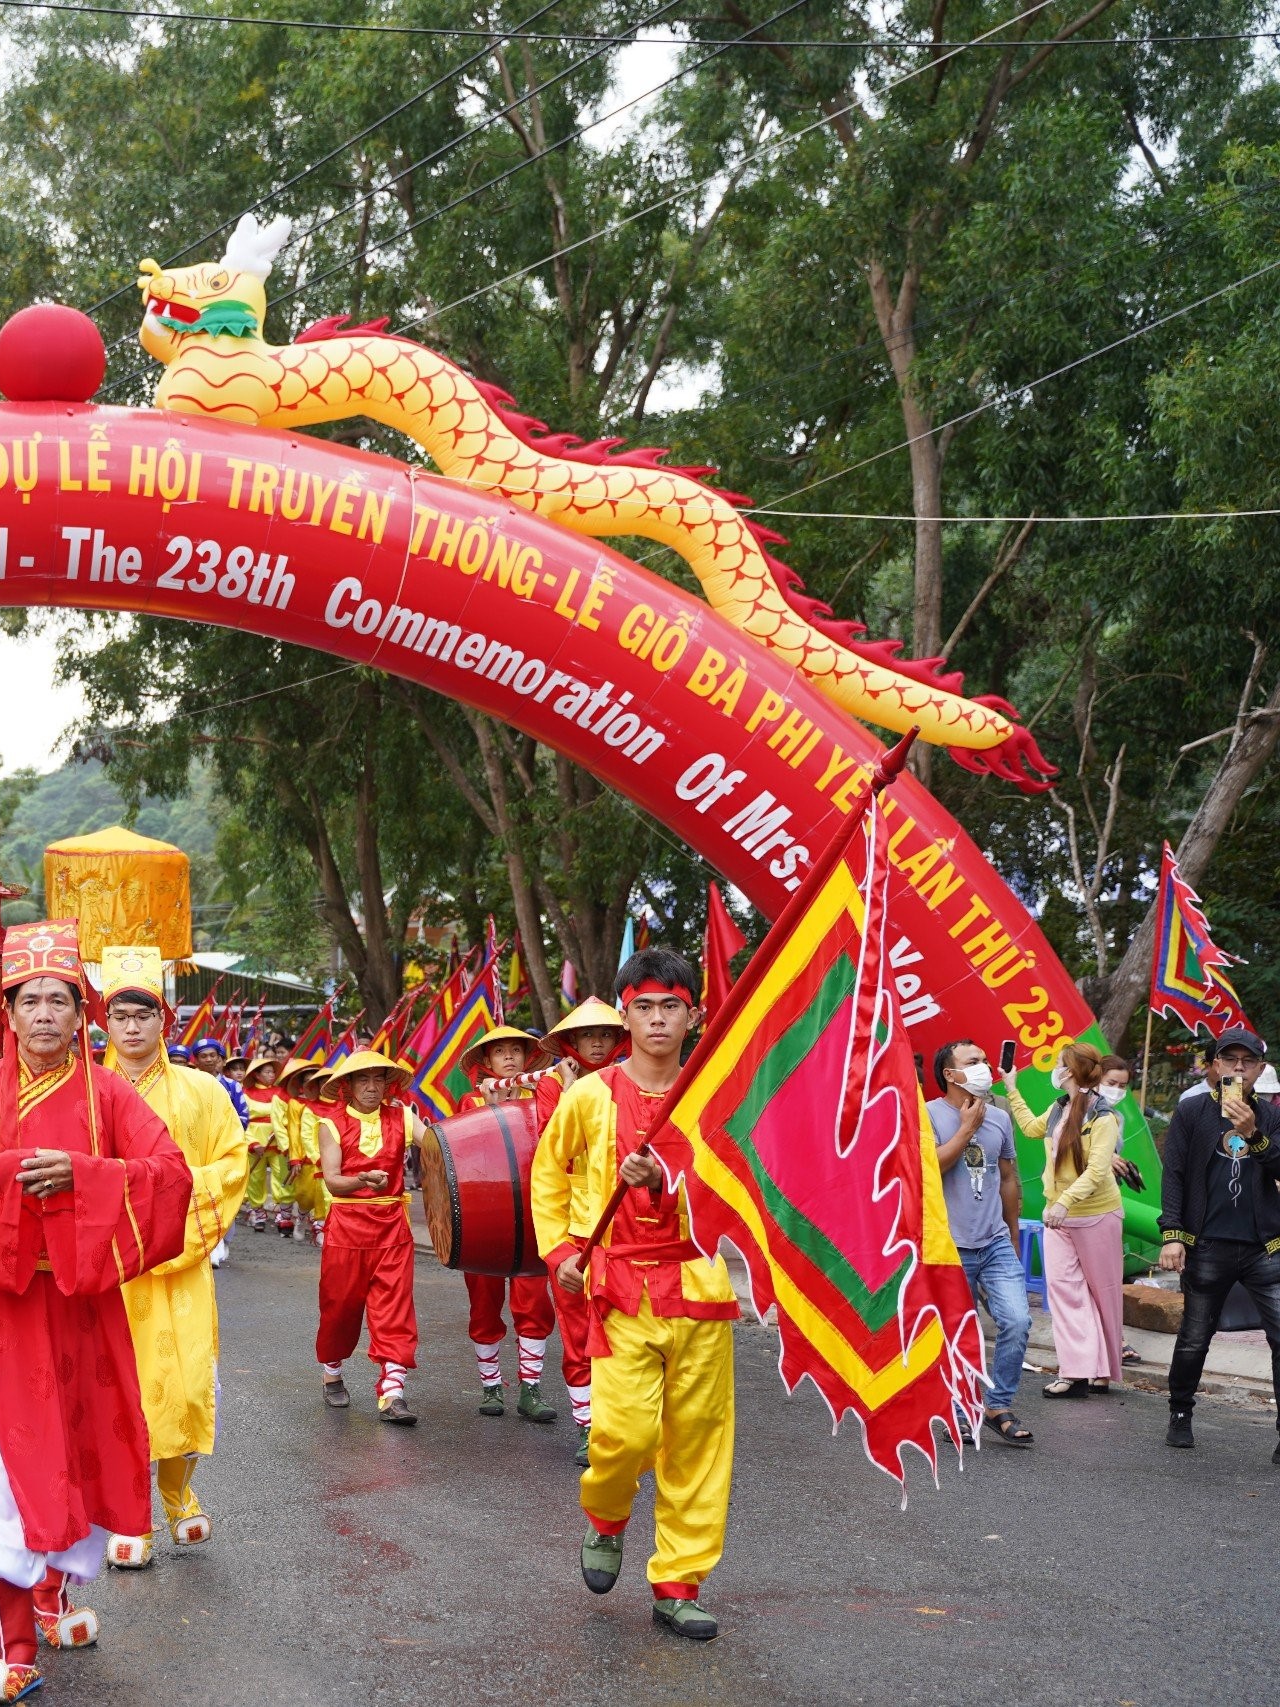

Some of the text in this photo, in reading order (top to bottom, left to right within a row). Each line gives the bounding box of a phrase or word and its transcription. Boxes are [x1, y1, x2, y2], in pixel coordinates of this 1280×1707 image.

[59, 422, 113, 493] LỄ
[128, 438, 203, 514] HỘI
[227, 457, 392, 546] TRUYỀN
[617, 603, 695, 673] GIỖ
[685, 645, 749, 717] BÀ
[745, 689, 825, 770] PHI
[887, 815, 966, 912] LẦN
[948, 893, 1036, 989] THỨ
[1002, 986, 1075, 1073] 238
[61, 526, 143, 584] The
[157, 535, 296, 609] 238th
[323, 575, 667, 765] Commemoration
[675, 752, 747, 814] Of
[721, 789, 810, 891] Mrs.
